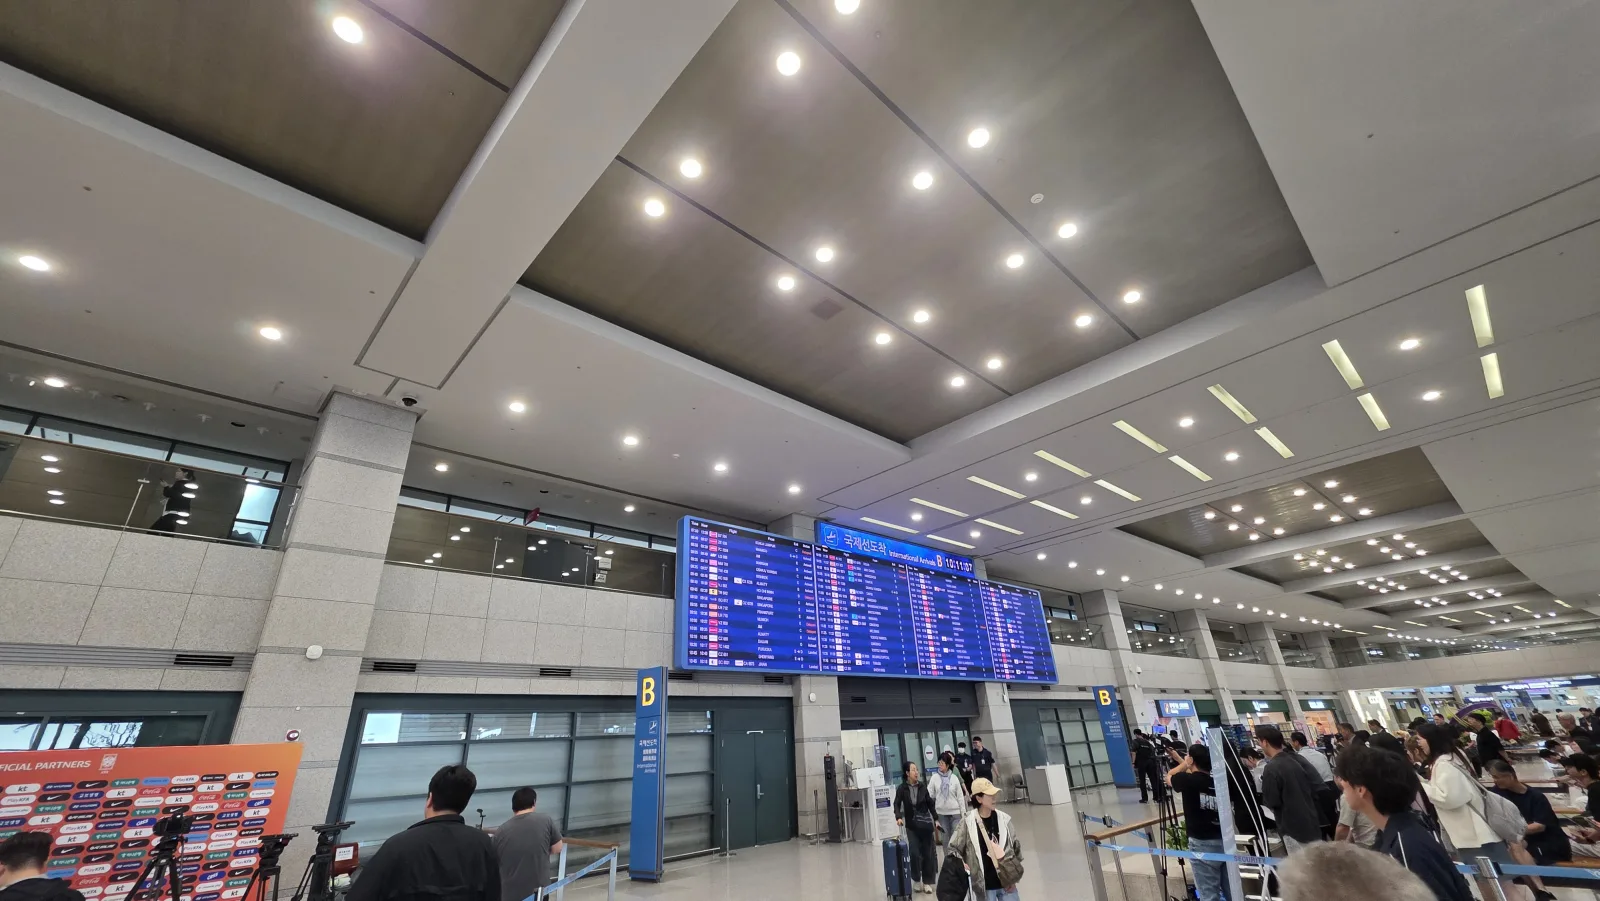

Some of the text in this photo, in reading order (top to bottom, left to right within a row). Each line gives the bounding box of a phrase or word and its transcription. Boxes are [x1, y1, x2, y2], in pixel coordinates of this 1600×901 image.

[844, 534, 886, 556] 국제선도착
[889, 550, 942, 567] International Arrivals B
[946, 558, 972, 572] 10:11:07
[642, 677, 655, 706] B
[1099, 689, 1111, 705] B
[35, 760, 91, 770] PARTNERS
[1234, 855, 1266, 864] SECURITY
